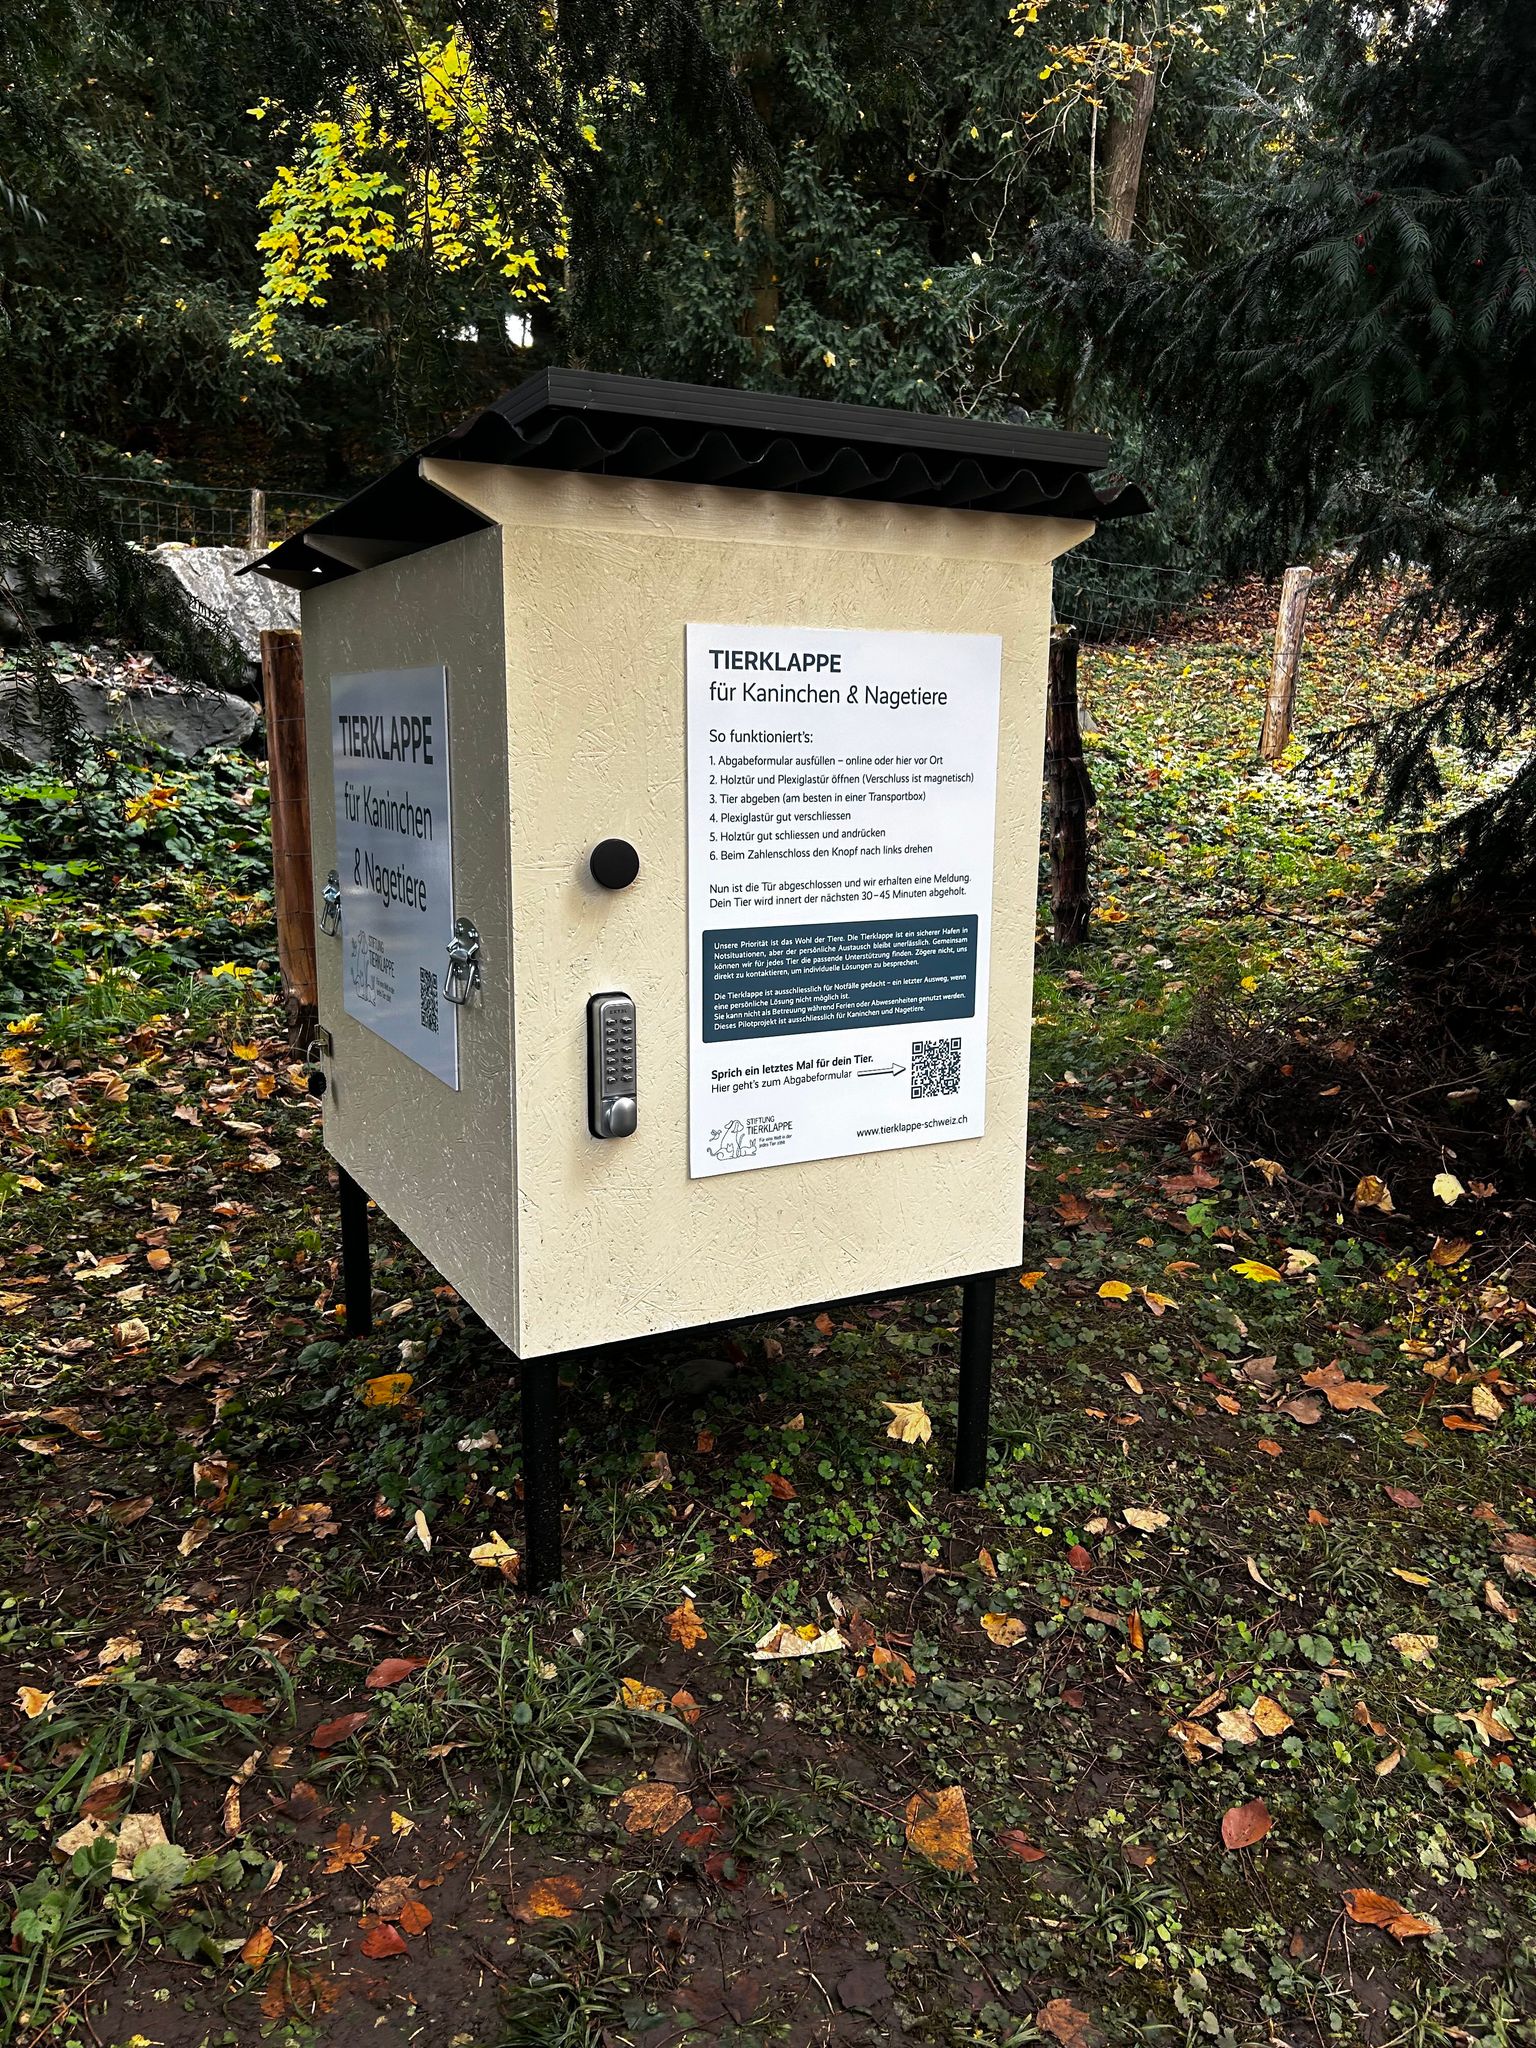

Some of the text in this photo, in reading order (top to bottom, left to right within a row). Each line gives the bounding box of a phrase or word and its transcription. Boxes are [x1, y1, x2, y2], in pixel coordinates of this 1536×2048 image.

[709, 649, 841, 673] TIERKLAPPE
[709, 681, 947, 709] für Kaninchen & Nagetiere
[338, 715, 433, 765] TIERKLAPPE
[709, 729, 726, 743] So
[709, 755, 943, 768] 1. Abgabeformular ausfüllen online oder hier vor Ort
[709, 773, 974, 787] 2. Holztür und Plexiglastür öffnen (Verschluss ist magnetisch)
[709, 791, 926, 806] 3. Tier abgeben (am besten in einer Transportbox)
[344, 781, 432, 841] für Kaninchen
[709, 811, 851, 825] 4. Plexiglastür gut verschliessen
[709, 828, 886, 843] 5. Holztür gut schliessen und andrücken
[709, 844, 933, 861] 6. Beim Zahlenschloss den Knopf nach links drehen
[354, 847, 427, 912] & Nagetiere
[710, 873, 971, 894] Nun ist die Tür abgeschlossen und wir erhalten eine Meldung.
[710, 898, 731, 908] Dein
[733, 897, 751, 907] Tier
[754, 896, 773, 906] wird
[776, 894, 802, 905] innert
[804, 894, 818, 904] der
[821, 893, 859, 902] nächsten
[892, 890, 927, 899] Minuten
[929, 886, 967, 899] abgeholt.
[714, 942, 738, 950] Unsere
[740, 940, 768, 948] Priorität
[794, 937, 812, 945] Wohl
[860, 932, 893, 940] Tierklappe
[916, 929, 941, 937] sicherer
[942, 927, 960, 935] Hafen
[766, 959, 784, 968] jedes
[813, 955, 843, 964] passende
[845, 952, 890, 961] Unterstützung
[915, 949, 936, 957] Zögere
[727, 991, 763, 999] Tierklappe
[774, 985, 822, 995] ausschliesslich
[834, 982, 859, 990] Notfälle
[860, 980, 886, 990] gedacht
[730, 1000, 768, 1010] persönliche
[770, 998, 794, 1006] Lösung
[813, 993, 839, 1003] möglich
[772, 1007, 806, 1015] Betreuung
[807, 1003, 835, 1012] während
[856, 1000, 870, 1008] oder
[871, 997, 918, 1006] Abwesenheiten
[918, 995, 942, 1004] genutzt
[738, 1018, 777, 1028] Pilotprojekt
[788, 1013, 835, 1023] ausschliesslich
[847, 1010, 880, 1018] Kaninchen
[881, 1007, 893, 1015] und
[711, 1054, 873, 1081] Sprich ein letztes Mal für dein Tier.
[712, 1080, 730, 1093] Hier
[762, 1079, 781, 1088] zum
[783, 1070, 852, 1086] Abgabeformular
[746, 1115, 775, 1126] STIFTUNG
[746, 1120, 793, 1135] TIERKLAPPE
[857, 1115, 968, 1137] www.tierklappe-schweiz.ch
